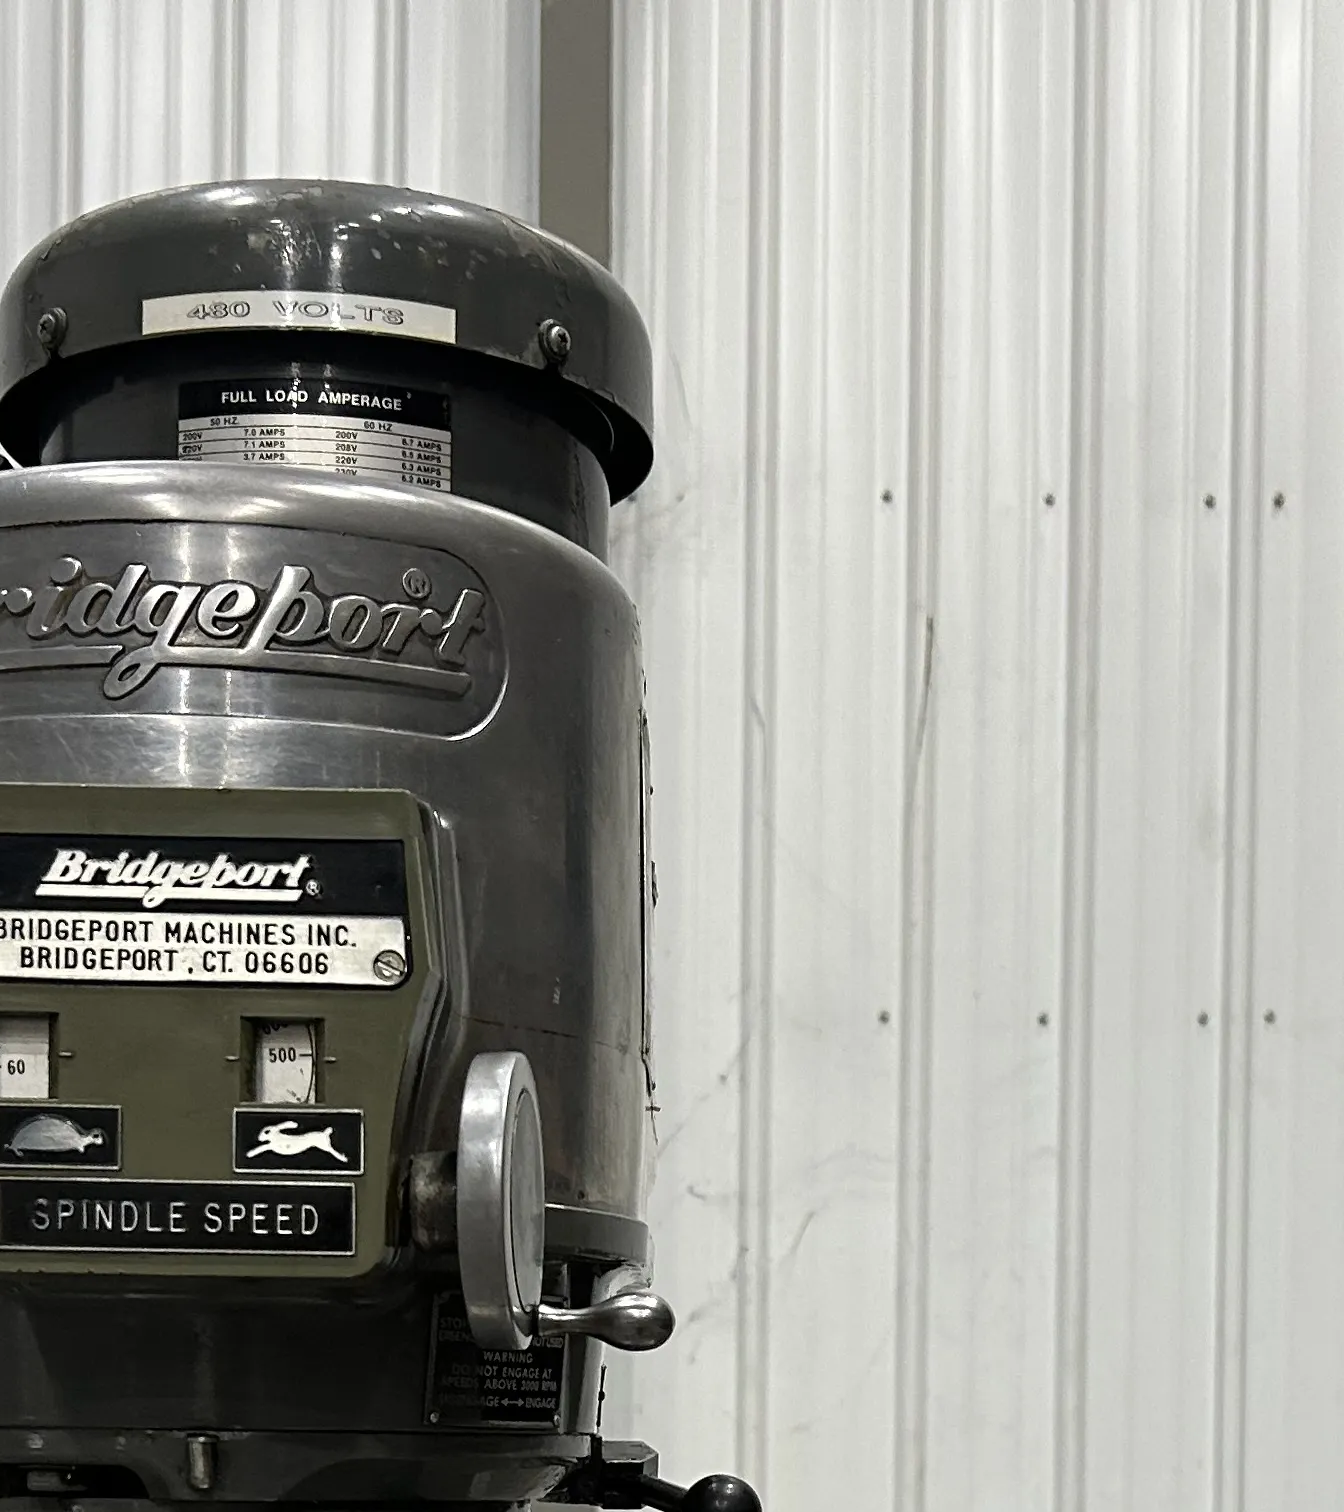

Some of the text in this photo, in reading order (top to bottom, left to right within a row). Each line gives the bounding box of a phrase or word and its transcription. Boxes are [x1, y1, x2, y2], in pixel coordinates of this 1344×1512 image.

[187, 301, 404, 325] 480 VOLTS
[221, 389, 403, 411] FULL LOAD AMPERAGE
[210, 418, 220, 426] 50
[363, 421, 393, 432] 60 HZ
[335, 431, 358, 440] 200V
[335, 443, 358, 452] 208V
[417, 440, 442, 452] AMPS
[258, 452, 285, 461] AMPS
[335, 456, 358, 465] 220V
[417, 452, 442, 464] AMPS
[417, 465, 442, 476] AMPS
[417, 477, 441, 489] AMPS
[40, 848, 311, 908] Bridgeport
[164, 922, 296, 946] MACHINES
[308, 926, 356, 947] INC.
[203, 951, 232, 974] CT.
[244, 951, 329, 975] 06606
[268, 1047, 297, 1063] 500
[7, 1059, 26, 1076] 60
[32, 1198, 319, 1236] SPINDLE SPEED
[483, 1351, 533, 1363] WARNING
[476, 1365, 497, 1377] NOT
[502, 1367, 540, 1379] ENGAGE
[542, 1368, 553, 1379] AT
[484, 1378, 518, 1390] ABOVE
[525, 1397, 556, 1409] ENGAGE
